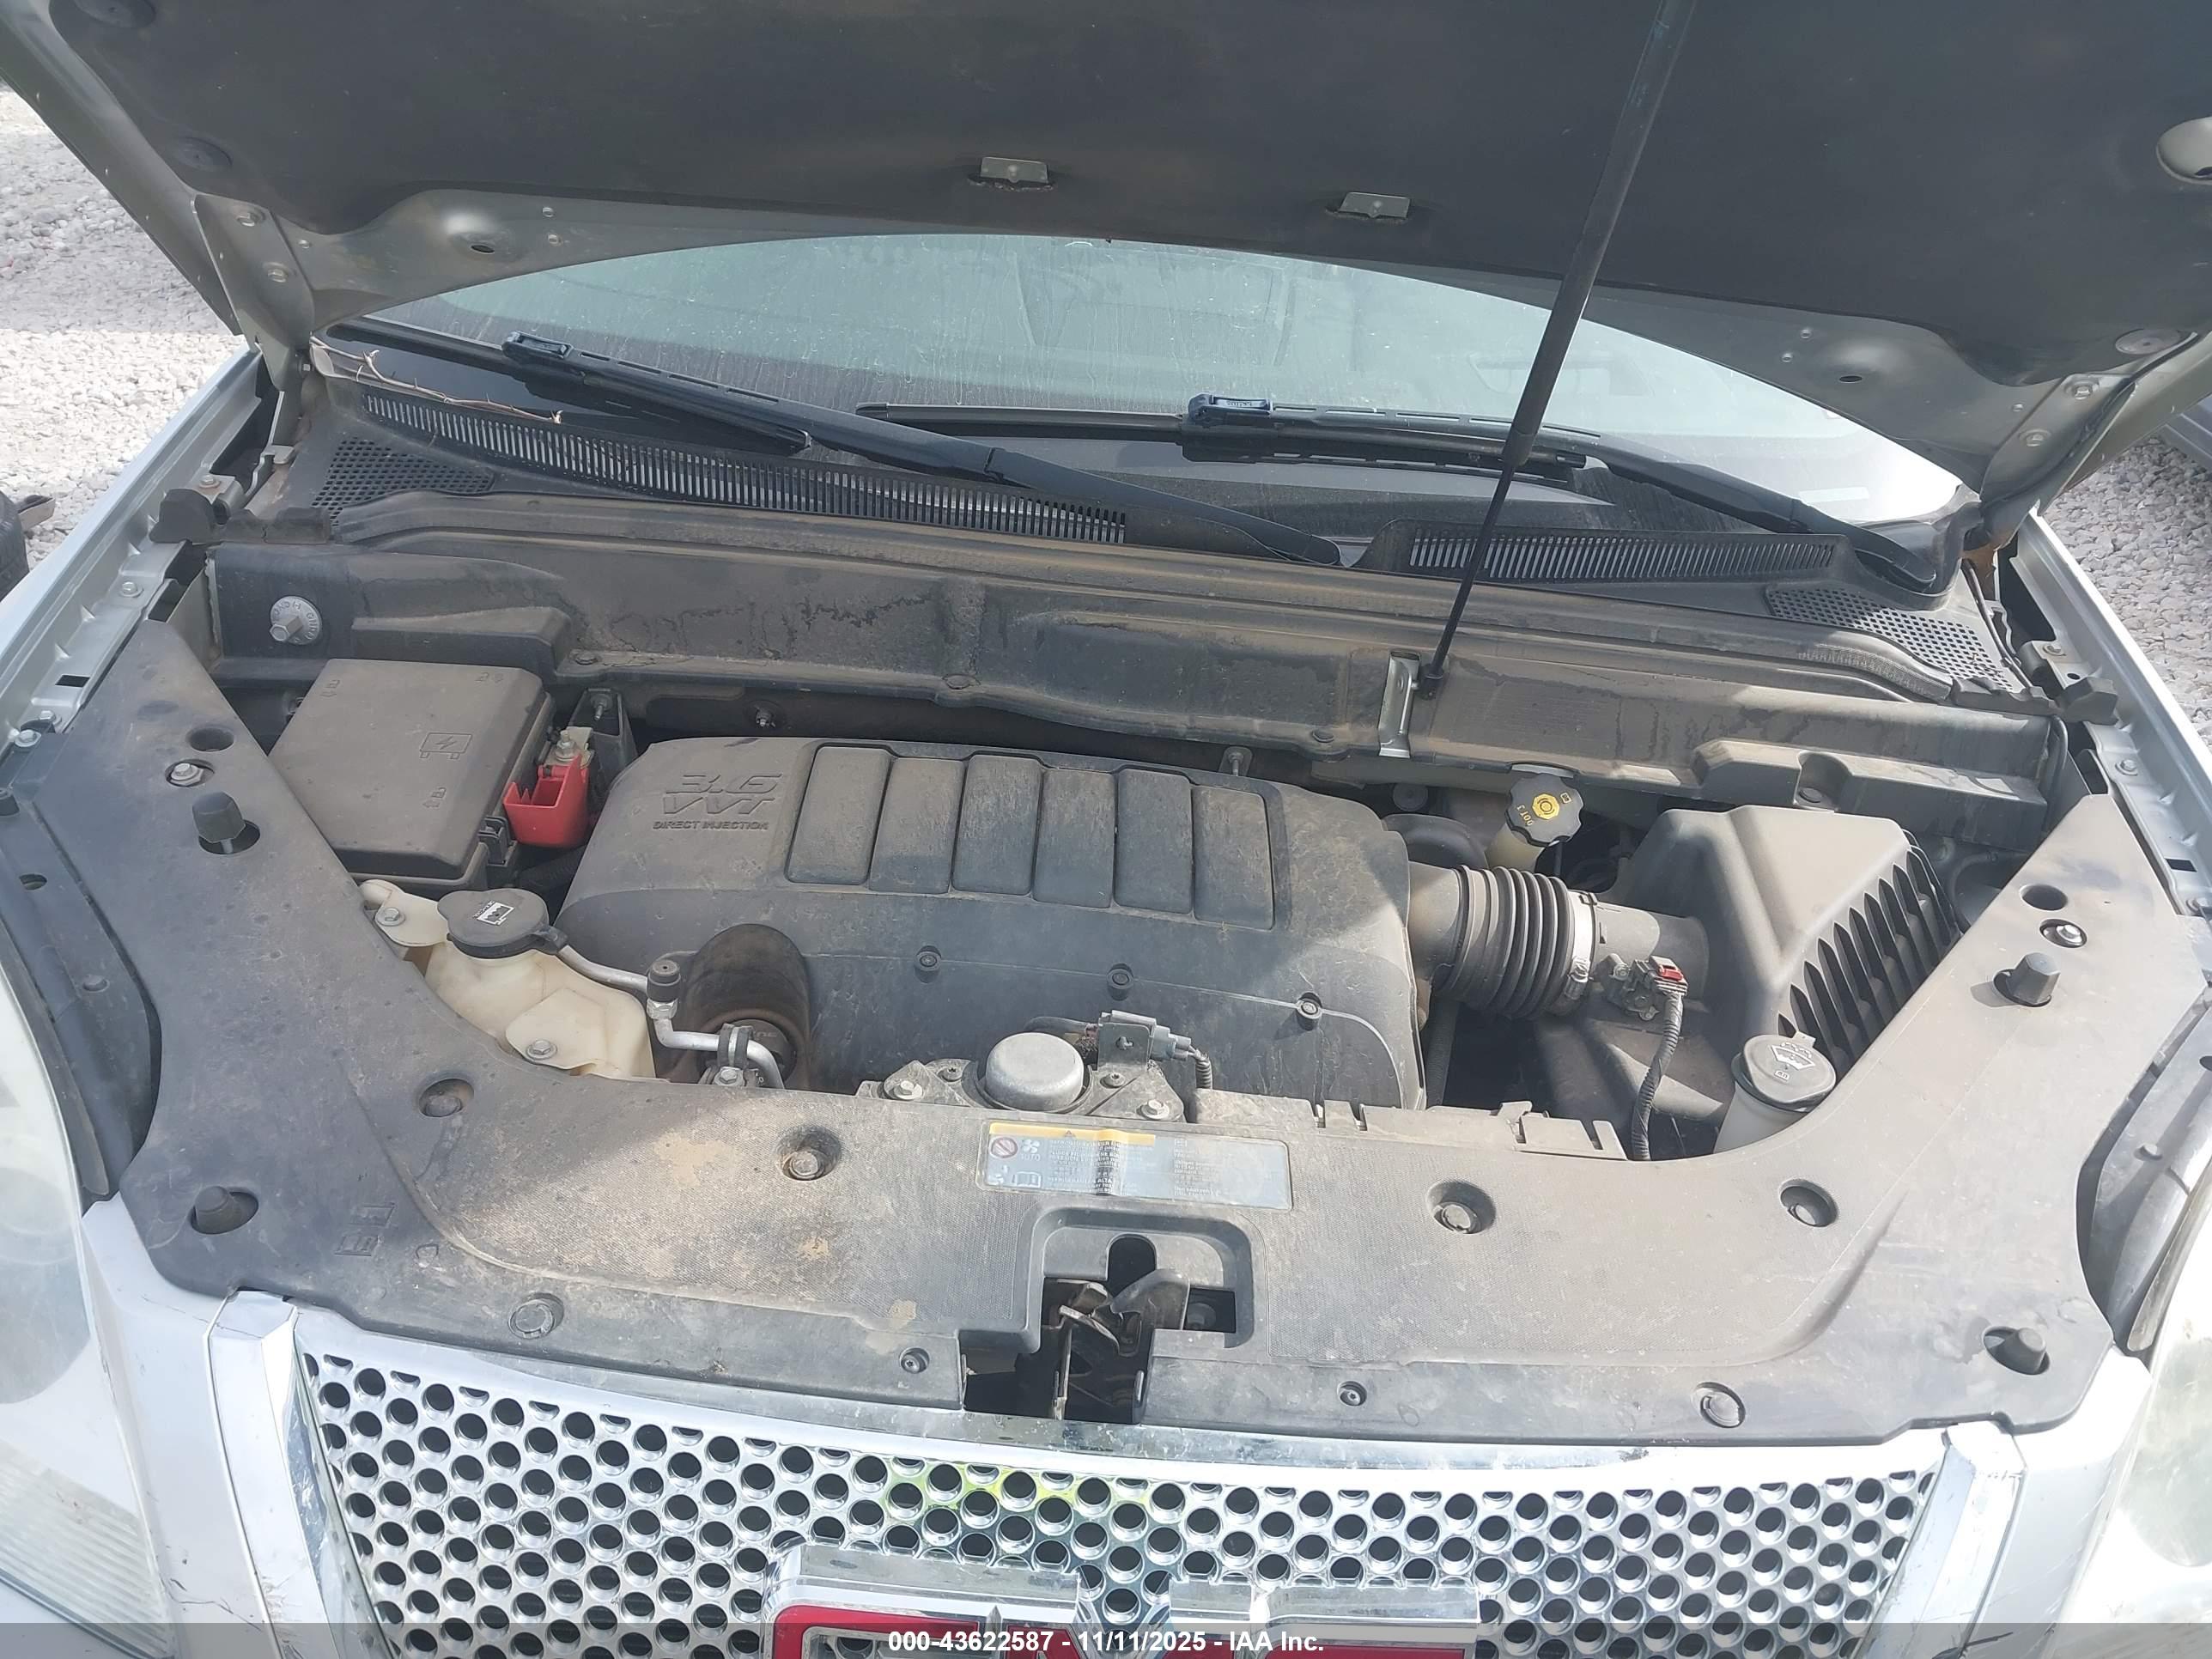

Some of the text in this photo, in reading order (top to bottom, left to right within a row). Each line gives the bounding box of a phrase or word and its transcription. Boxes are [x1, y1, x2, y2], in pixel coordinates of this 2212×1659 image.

[665, 774, 782, 794] 3.6
[663, 796, 775, 815] VVT
[653, 820, 770, 831] DIRECT INJECTION
[1519, 811, 1534, 826] DOT
